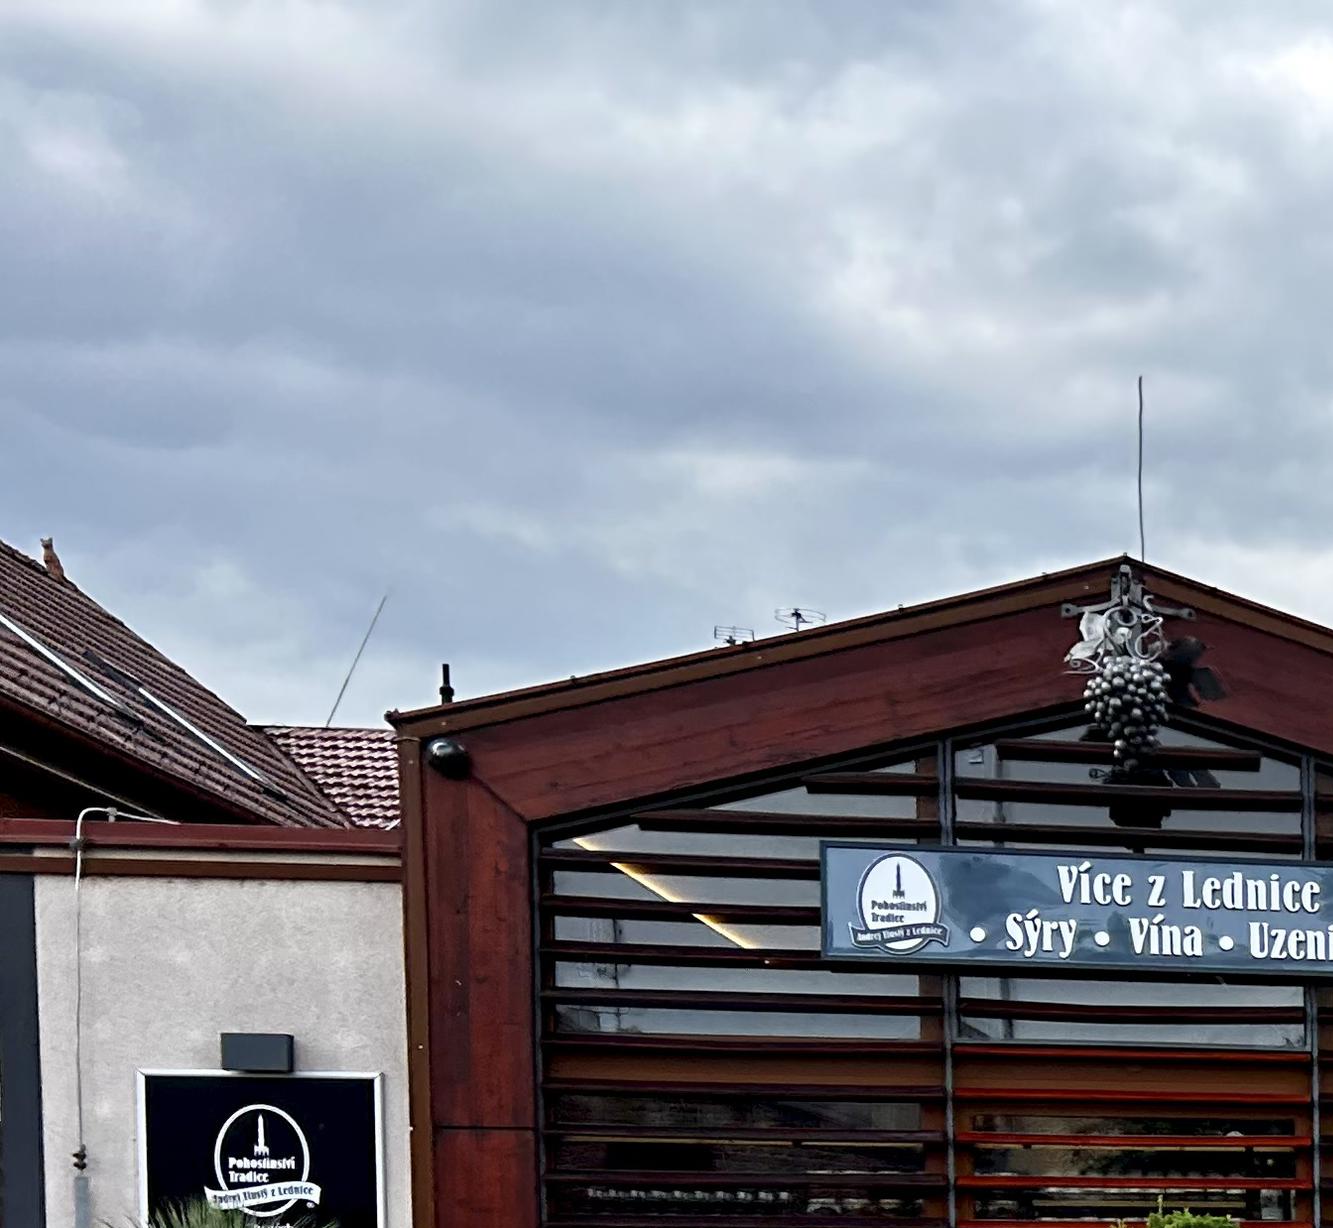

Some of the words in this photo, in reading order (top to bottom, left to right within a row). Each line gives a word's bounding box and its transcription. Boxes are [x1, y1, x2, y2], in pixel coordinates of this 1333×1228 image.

[1057, 861, 1131, 906] Více
[1148, 875, 1165, 906] z
[1182, 870, 1322, 913] Lednice
[1005, 910, 1077, 960] Sýry
[1129, 914, 1203, 957] Vína
